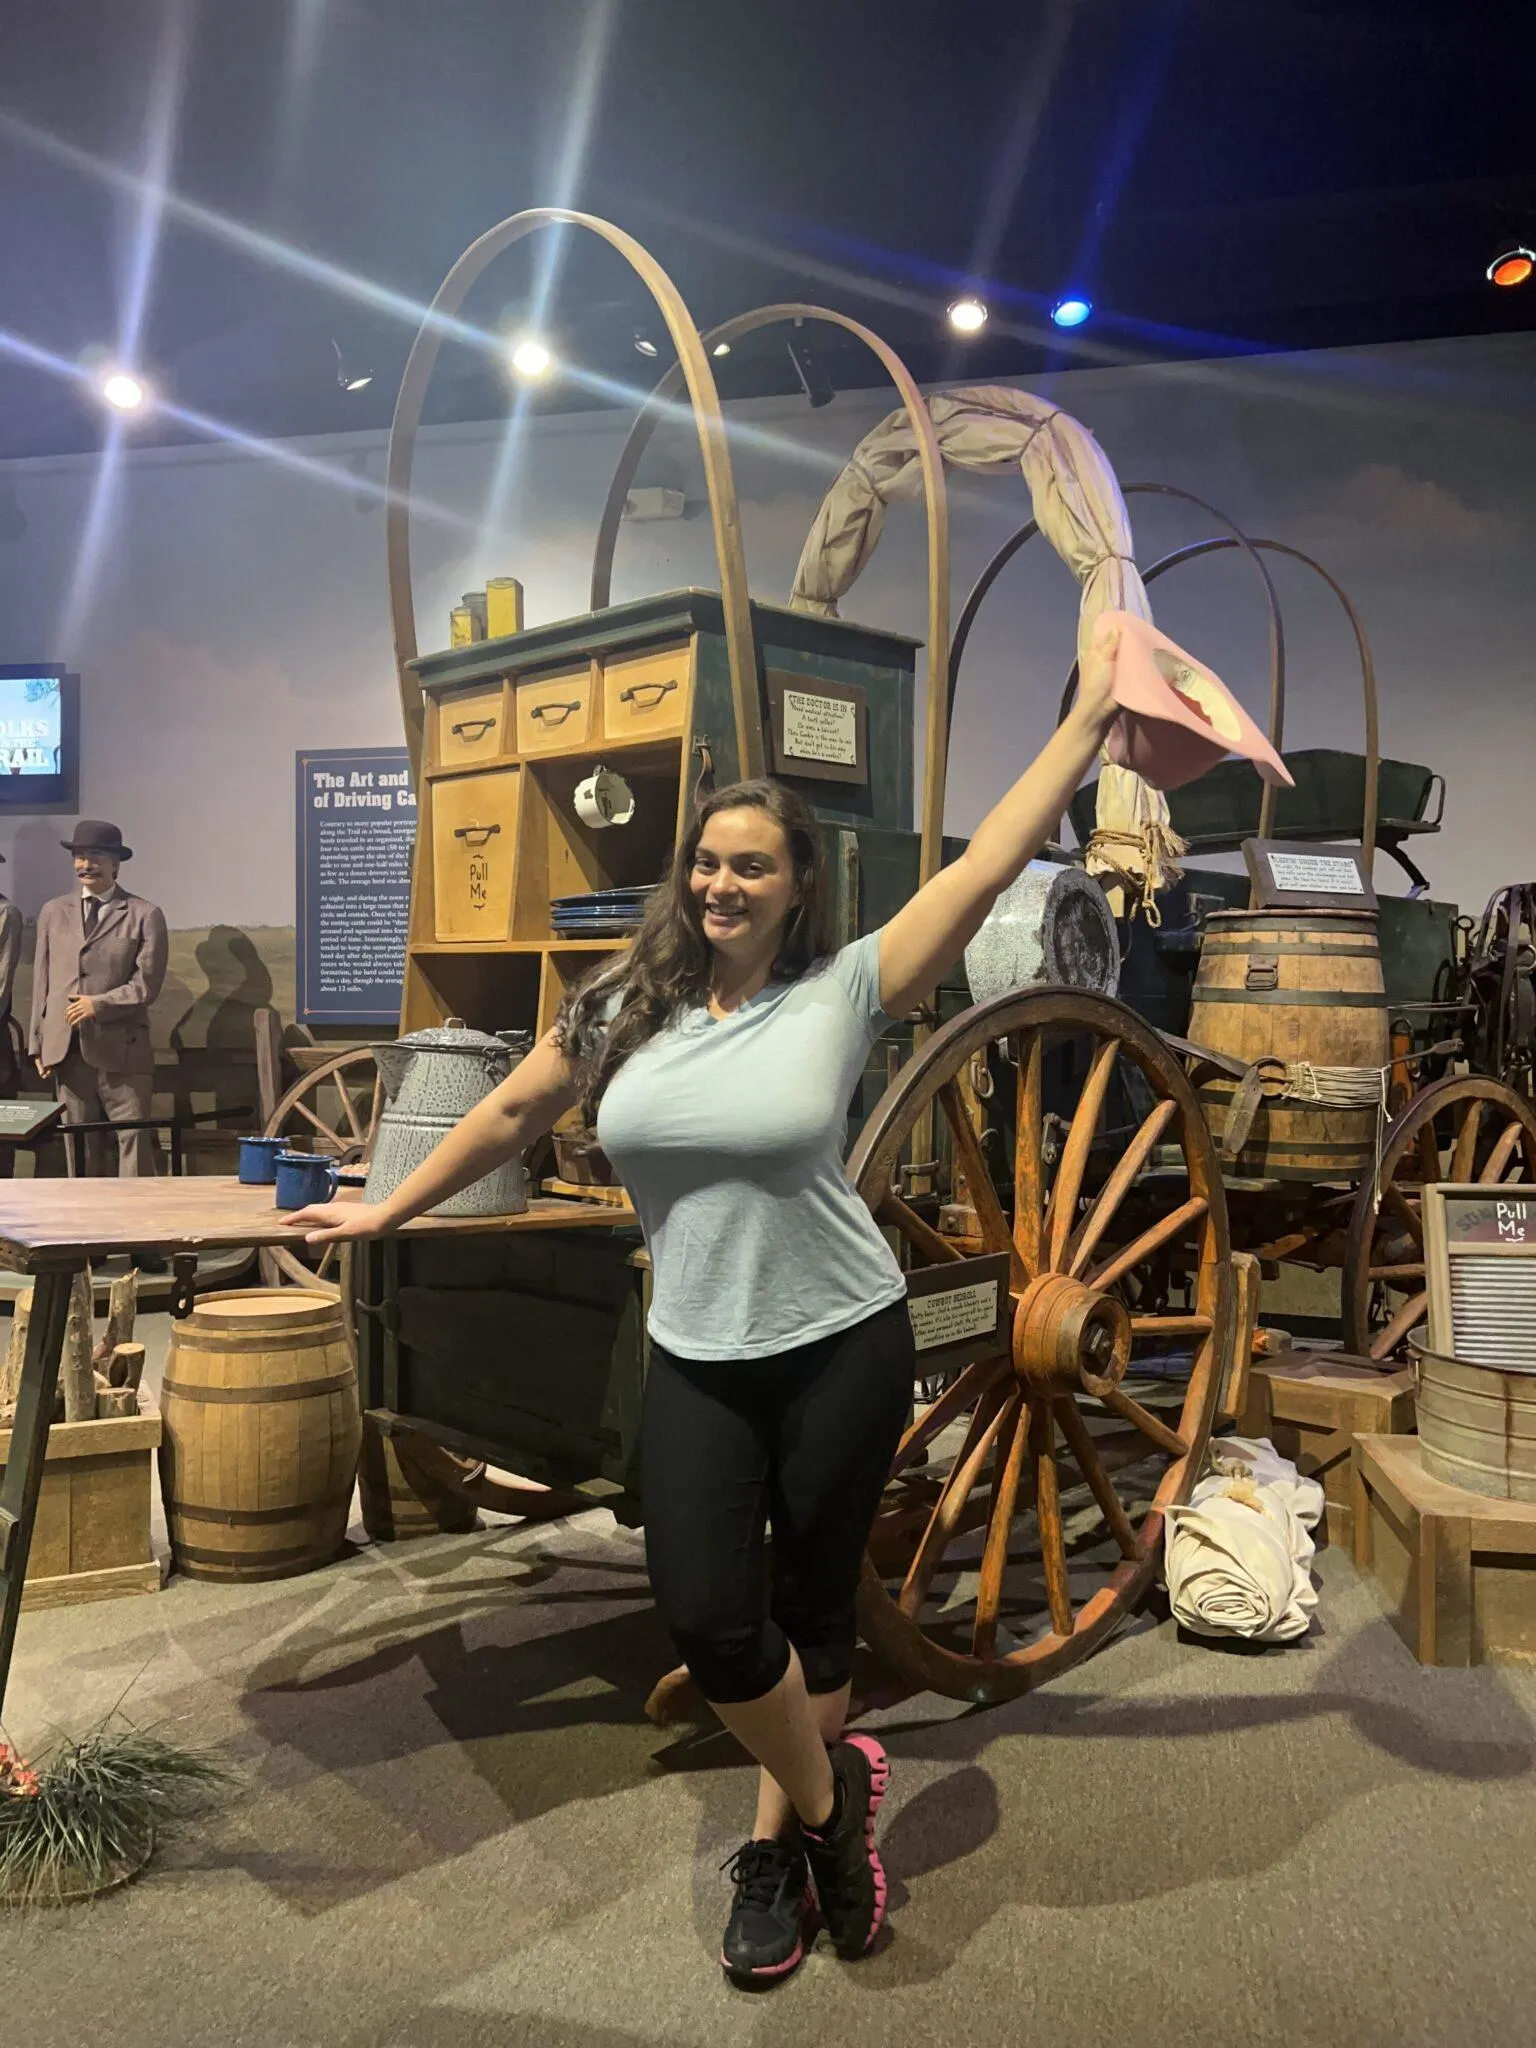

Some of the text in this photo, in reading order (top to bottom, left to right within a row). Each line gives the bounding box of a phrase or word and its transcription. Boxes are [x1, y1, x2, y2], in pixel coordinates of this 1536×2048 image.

[807, 698, 831, 709] DOCTOR
[314, 770, 409, 788] The Art and
[314, 792, 329, 808] of
[334, 791, 392, 810] Driving
[470, 862, 488, 881] Pull
[470, 883, 486, 899] Me
[1496, 1202, 1526, 1220] Pull
[1498, 1220, 1525, 1236] Me
[927, 1290, 976, 1308] COWBOY BEDROLL
